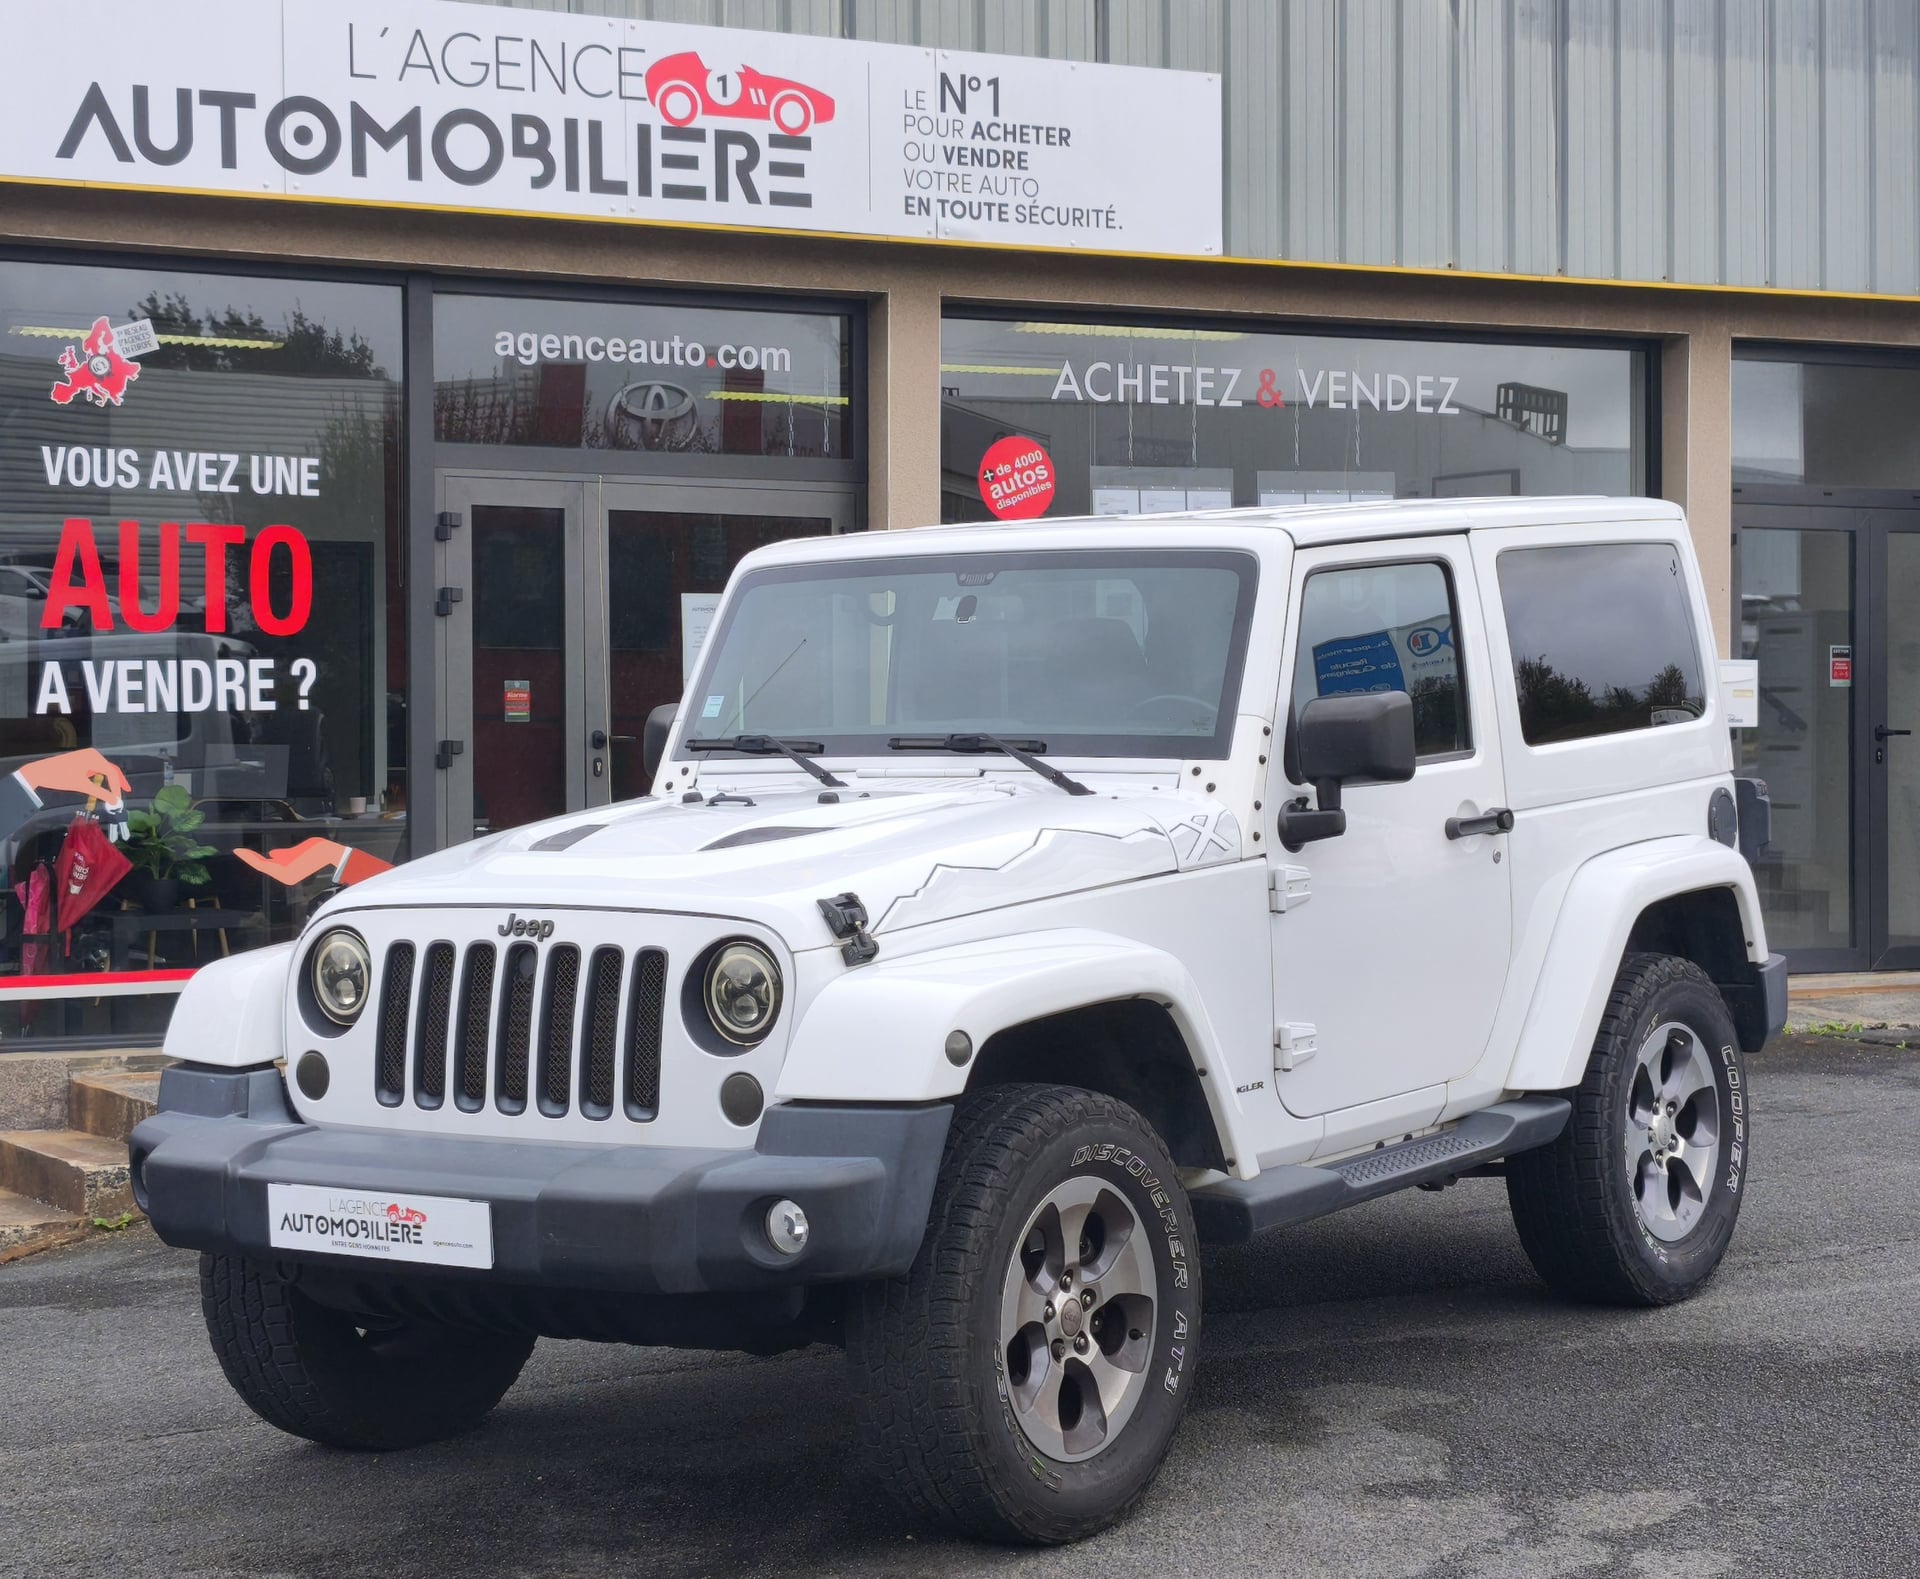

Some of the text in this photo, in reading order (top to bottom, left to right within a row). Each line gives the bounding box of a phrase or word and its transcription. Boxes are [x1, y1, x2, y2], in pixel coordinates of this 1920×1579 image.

[716, 75, 728, 98] 1
[904, 89, 926, 111] LE
[55, 81, 812, 208] AUTOMOBILIERE
[903, 114, 1072, 148] POUR ACHETER
[903, 141, 1030, 171] OU VENDRE
[903, 168, 1040, 198] VOTRE AUTO
[904, 195, 1124, 230] EN TOUTE SÉCURITÉ.
[494, 330, 791, 372] agenceauto.com
[1051, 359, 1460, 415] ACHETEZ & VENDEZ
[40, 446, 320, 496] VOUS AVEZ UNE
[996, 463, 1012, 476] de
[1014, 450, 1043, 469] 4000
[989, 464, 1049, 500] autos
[996, 481, 1053, 510] disponibles
[40, 518, 313, 637] AUTO
[36, 658, 317, 714] A VENDRE ?
[497, 913, 555, 943] Jeep
[1721, 1044, 1744, 1193] COOPER
[328, 1197, 387, 1217] L'AGENCE
[1070, 1143, 1188, 1290] DISCOVERER
[280, 1213, 423, 1245] AUTOMOBILIERE
[432, 1240, 474, 1249] agenceauto.com
